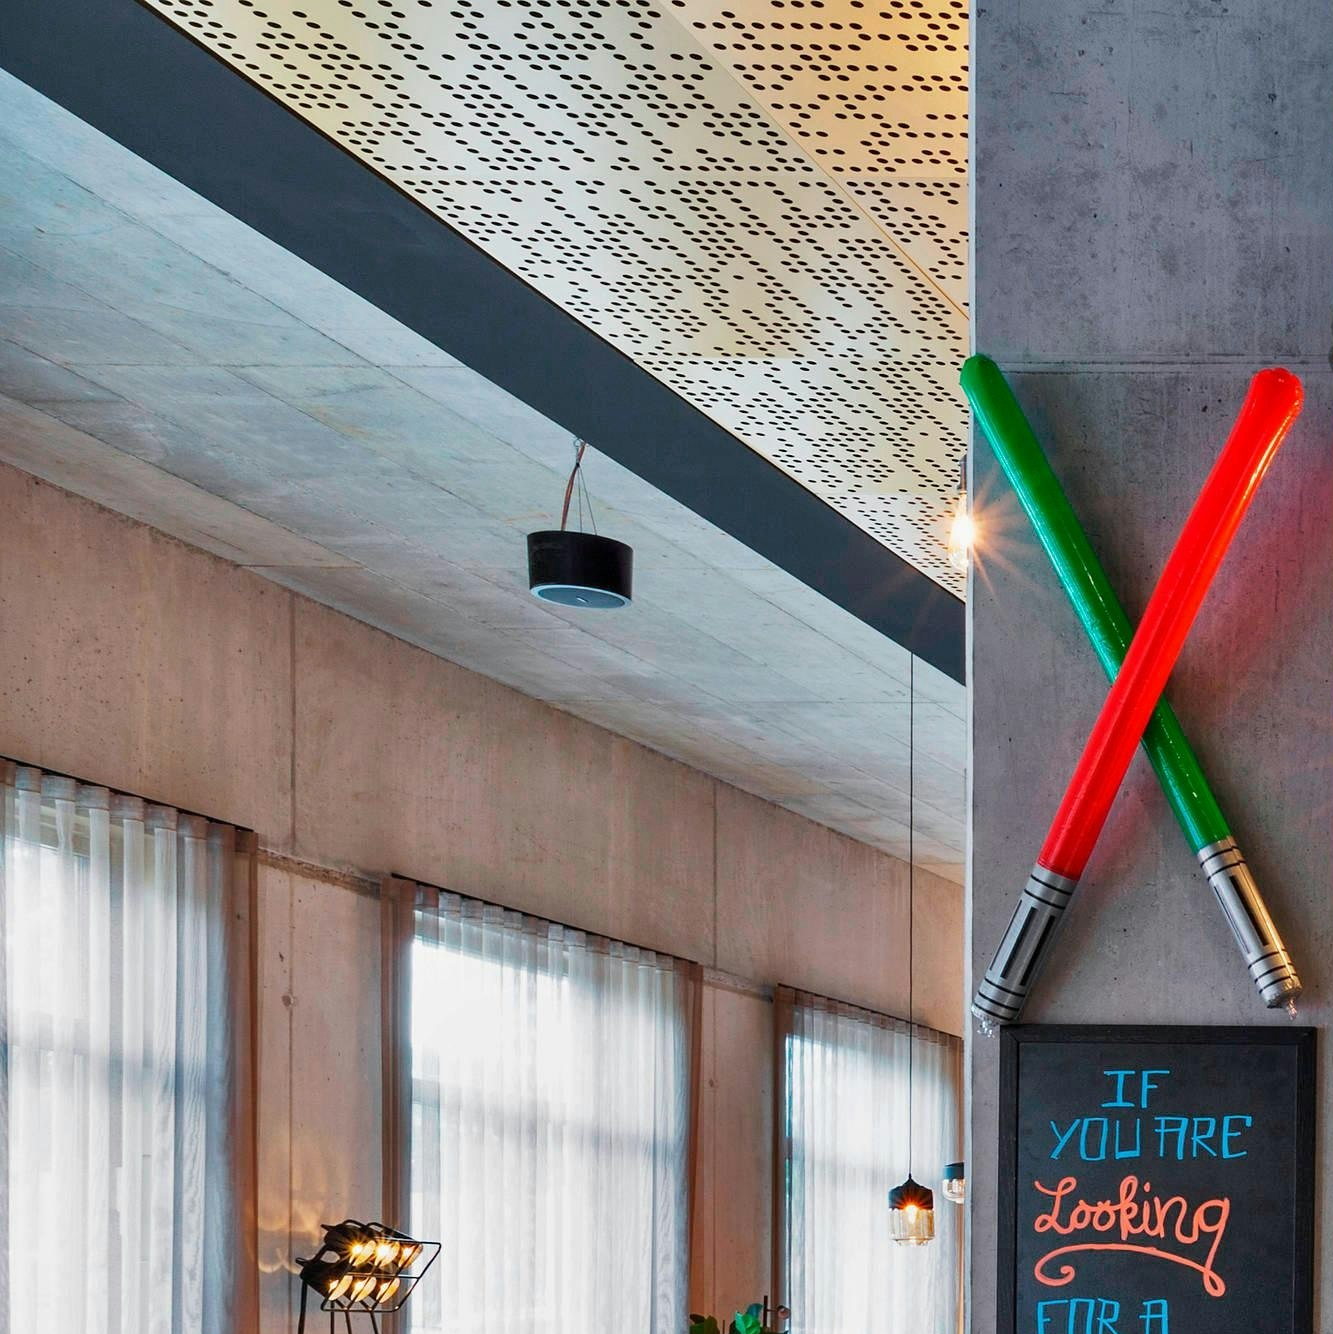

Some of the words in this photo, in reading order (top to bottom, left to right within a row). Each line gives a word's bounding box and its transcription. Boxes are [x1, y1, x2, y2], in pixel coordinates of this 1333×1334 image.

[1101, 1069, 1171, 1108] IF
[1050, 1117, 1140, 1161] YOU
[1154, 1115, 1252, 1160] ARE
[1034, 1175, 1230, 1297] Looking
